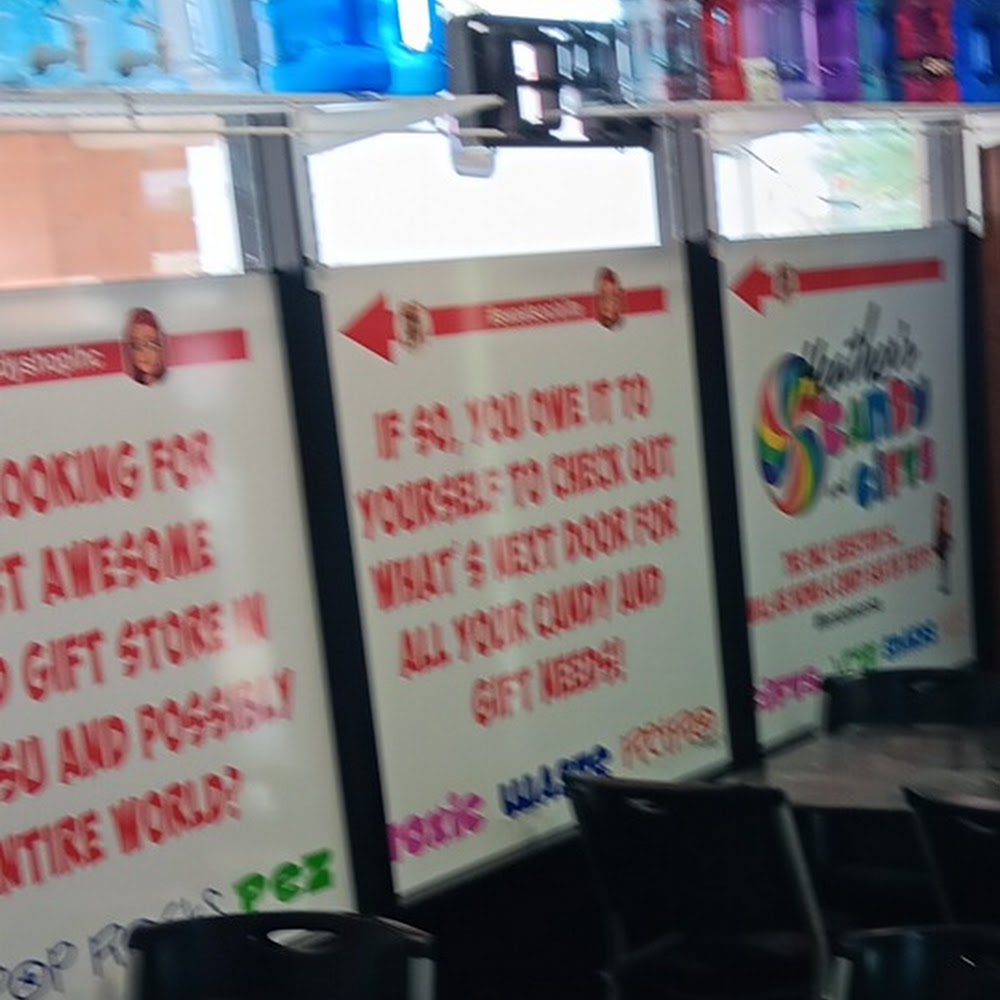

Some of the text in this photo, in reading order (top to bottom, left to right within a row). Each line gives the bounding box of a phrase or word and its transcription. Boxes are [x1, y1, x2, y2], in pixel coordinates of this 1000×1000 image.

[373, 372, 651, 460] IF SO, YOU OWE IT TO
[0, 429, 215, 518] OOKING FOR
[355, 433, 677, 541] YOURSELF TO CHECK OUT
[0, 519, 216, 612] T AWESOME
[490, 524, 558, 581] NEXT
[562, 505, 631, 562] DOOR
[632, 495, 680, 544] FOR
[22, 629, 105, 702] GIFT
[118, 601, 225, 678] STORE
[399, 563, 666, 680] ALL YOUR CANDY AND
[470, 667, 534, 728] GIFT
[56, 714, 130, 786] AND
[108, 763, 245, 857] WORLD?
